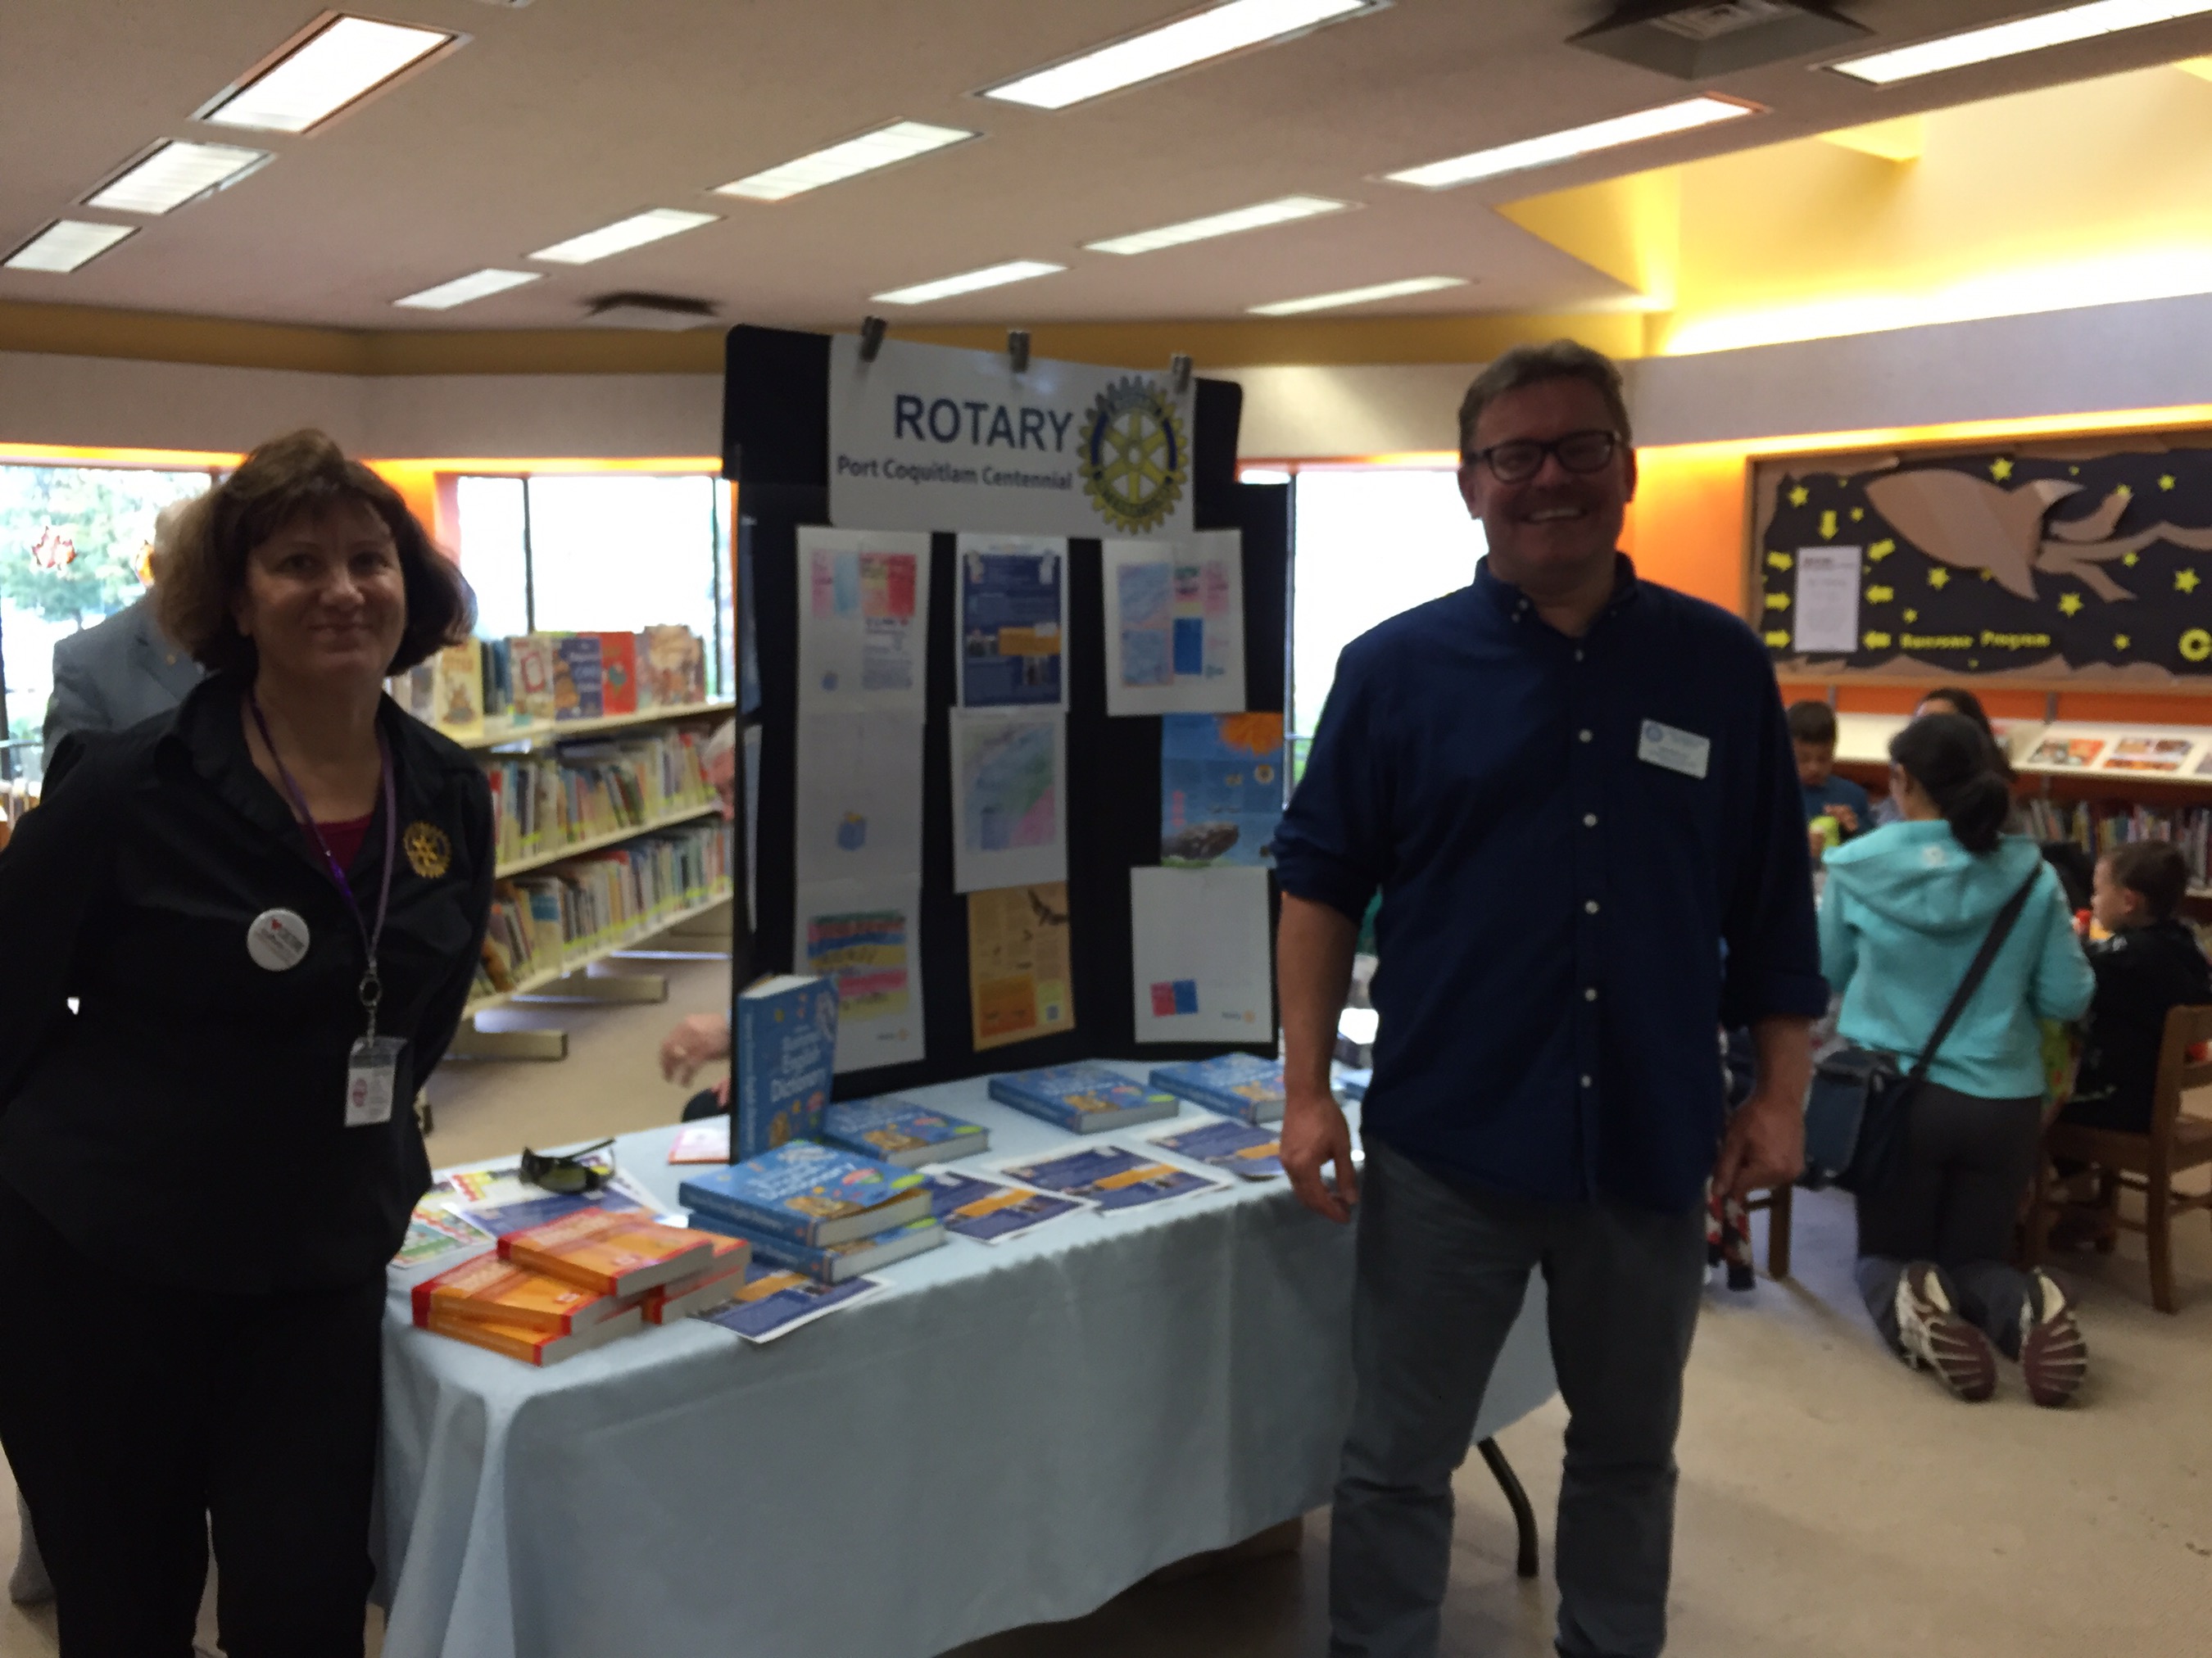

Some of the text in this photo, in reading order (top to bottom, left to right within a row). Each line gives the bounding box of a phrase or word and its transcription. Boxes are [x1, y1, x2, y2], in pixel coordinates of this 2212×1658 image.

[895, 393, 1073, 452] ROTARY
[836, 455, 1072, 491] Port Coquitlam Centennial
